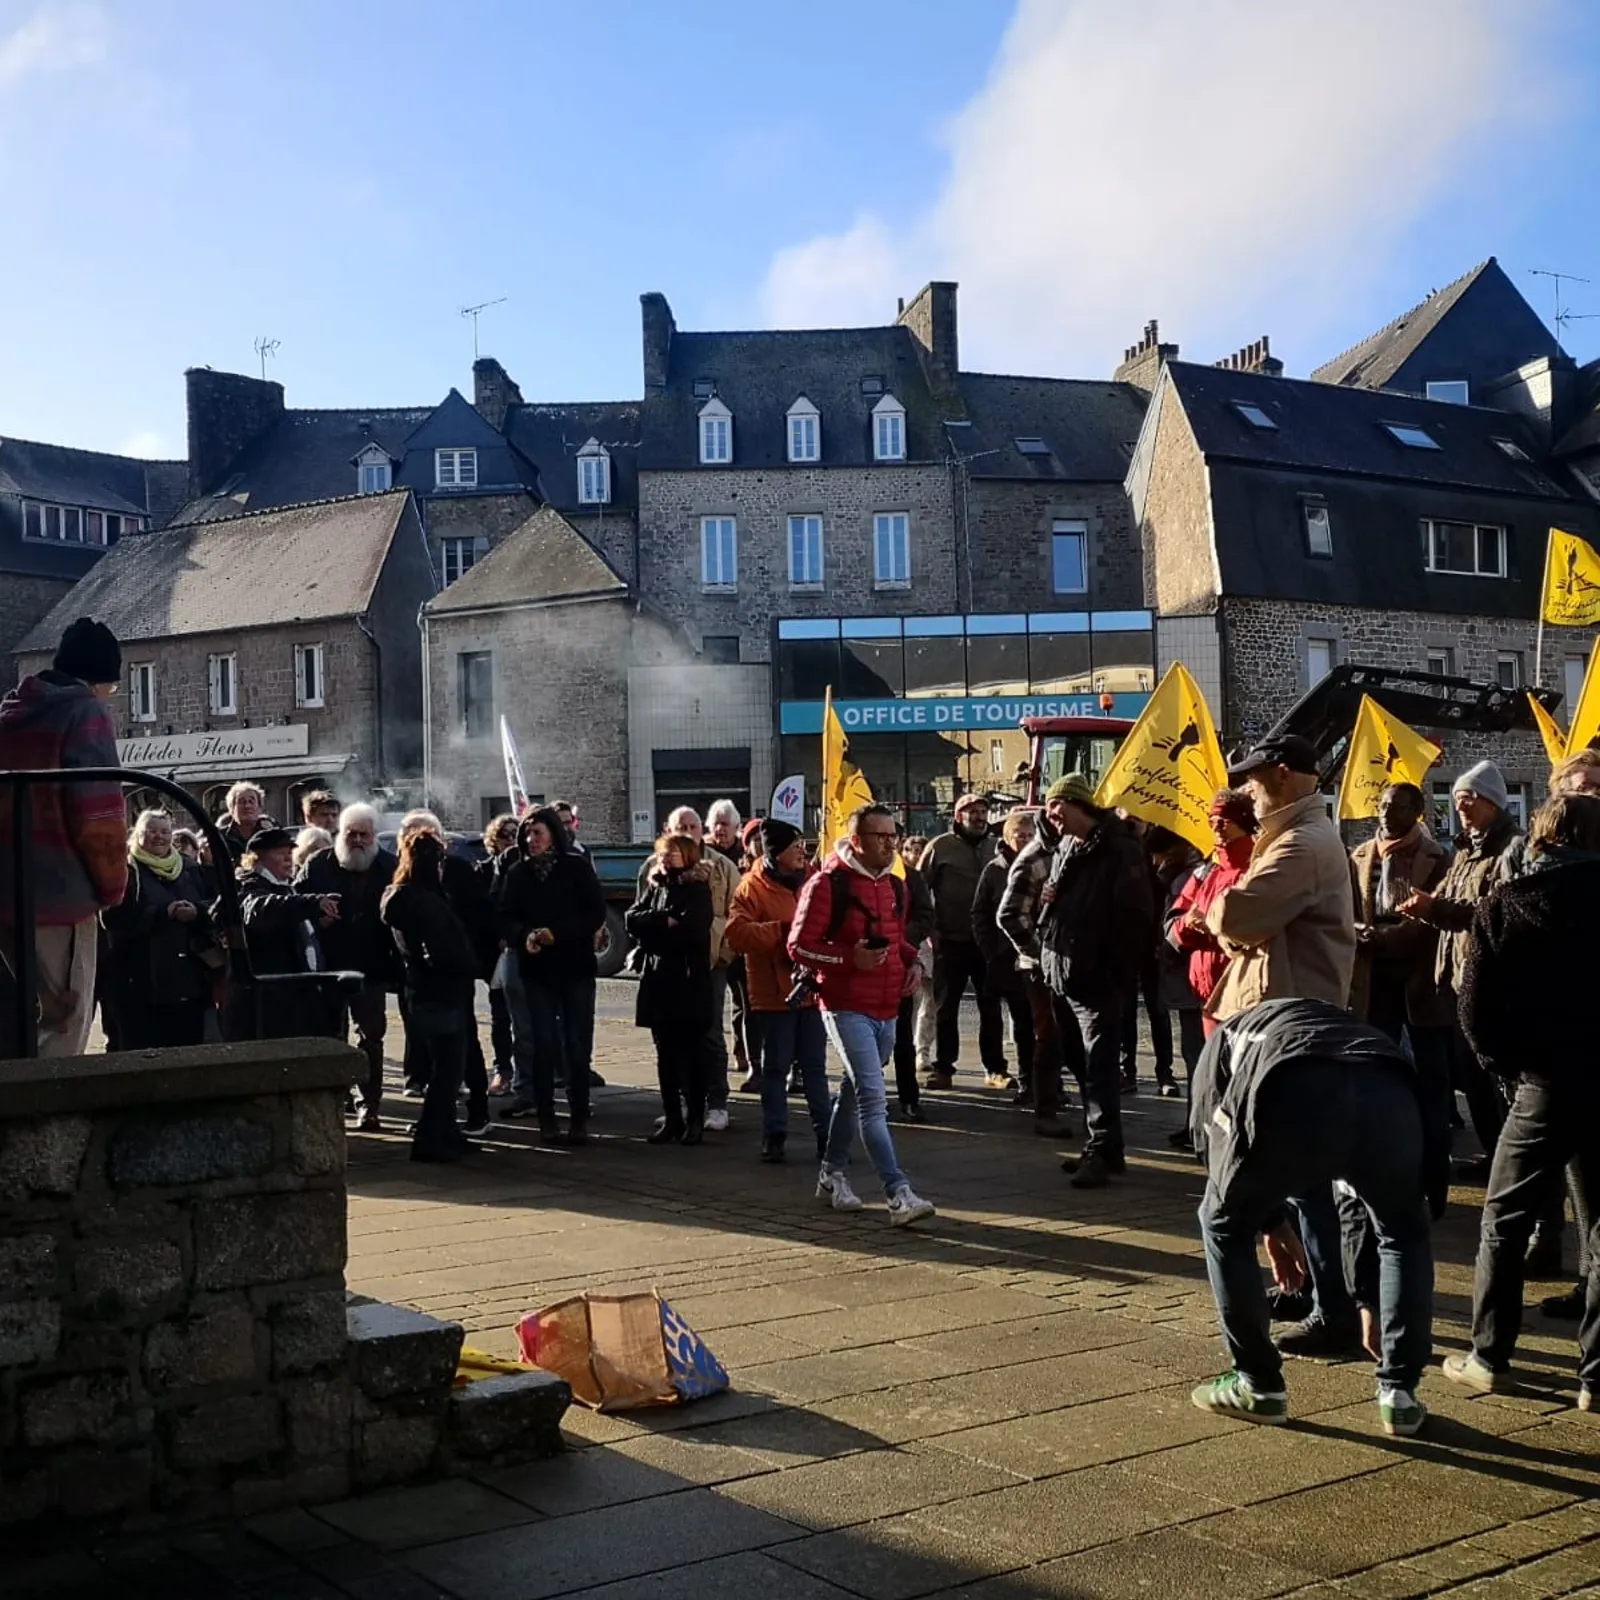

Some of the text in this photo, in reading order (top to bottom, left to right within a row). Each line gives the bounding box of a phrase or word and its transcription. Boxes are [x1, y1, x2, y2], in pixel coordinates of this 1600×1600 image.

[843, 702, 1094, 726] OFFICE DE TOURISME
[196, 737, 255, 757] Fleurs
[1121, 782, 1201, 826] paysanne
